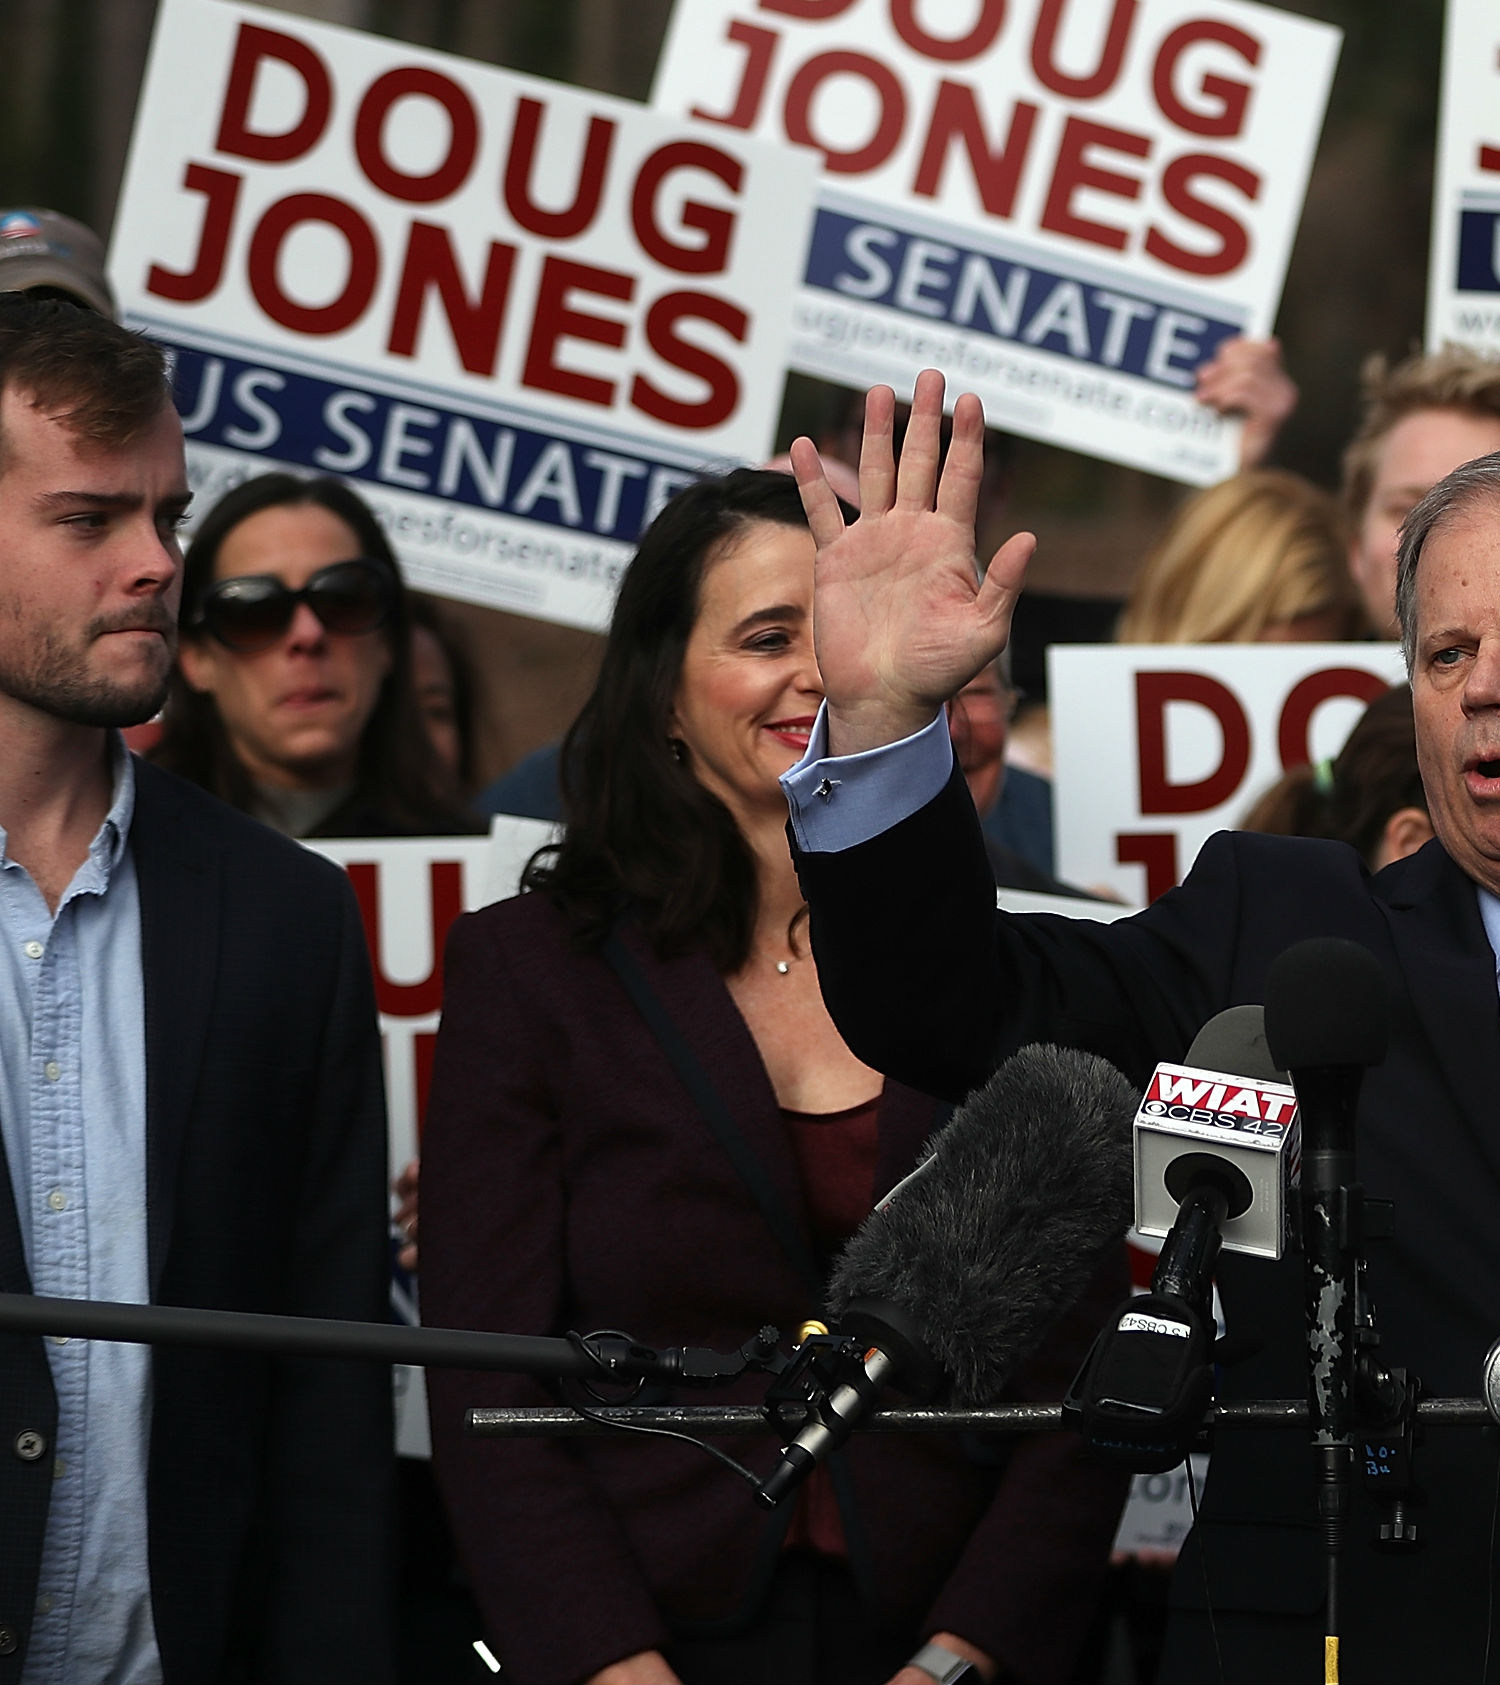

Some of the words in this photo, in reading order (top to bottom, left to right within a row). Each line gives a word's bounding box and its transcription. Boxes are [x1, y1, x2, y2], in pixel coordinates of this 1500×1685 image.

[215, 22, 748, 277] DOUG
[689, 19, 1267, 278] JONES
[757, 0, 1265, 139] OUG
[146, 162, 751, 432] JONES
[833, 223, 1209, 388] SENATE
[1157, 1073, 1297, 1122] WIAT
[1168, 1105, 1238, 1129] CBS
[1243, 1120, 1284, 1138] 42
